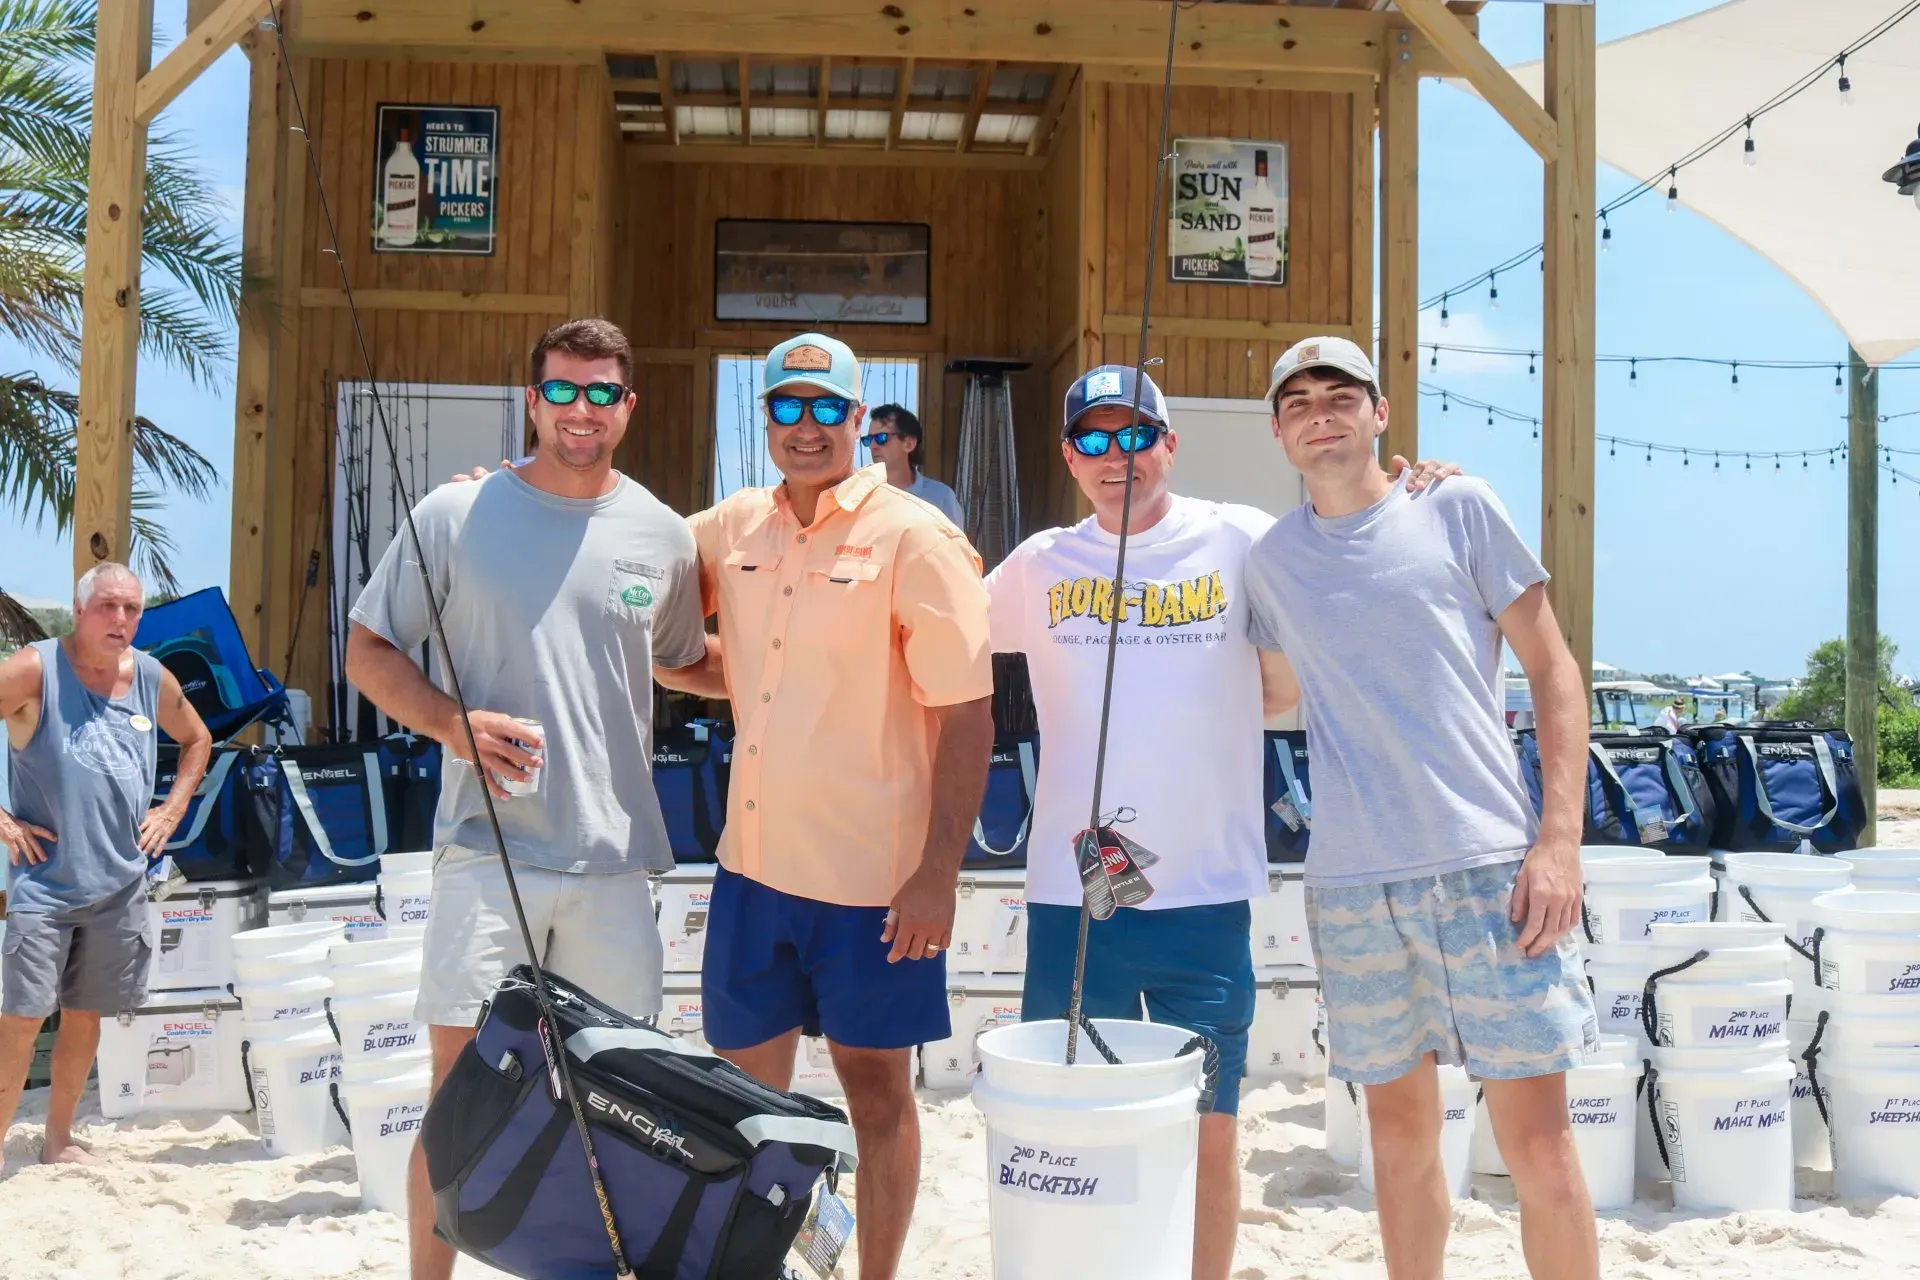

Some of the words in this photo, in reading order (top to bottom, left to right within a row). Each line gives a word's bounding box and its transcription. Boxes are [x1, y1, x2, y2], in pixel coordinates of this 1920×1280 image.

[454, 123, 464, 131] TO
[425, 136, 488, 153] STRUMMER
[1207, 160, 1221, 169] well
[1223, 160, 1238, 169] with
[424, 158, 489, 197] TIME
[1178, 172, 1242, 201] SUN
[440, 201, 484, 217] PICKERS
[1204, 200, 1219, 208] and
[1181, 212, 1241, 231] SAND
[1182, 258, 1219, 272] PICKERS
[1048, 570, 1228, 628] FLORA-BAMA
[1052, 634, 1083, 645] OUNGE,
[1085, 635, 1140, 645] PACAGE
[1144, 635, 1152, 645] &
[1156, 633, 1202, 644] OYSTER
[1205, 632, 1227, 642] BAR
[652, 754, 688, 762] NGEL
[1102, 850, 1125, 868] ENN
[1113, 879, 1133, 889] ATTLE
[400, 898, 414, 908] 3RD
[163, 910, 212, 918] ENGEL
[1650, 911, 1668, 922] 3RD
[1671, 910, 1690, 918] PLACE
[961, 942, 968, 951] 19
[1268, 936, 1275, 945] 19
[1615, 995, 1630, 1004] 2ND
[273, 1008, 288, 1019] 2ND
[291, 1007, 311, 1015] PLACE
[1611, 1006, 1630, 1018] RED
[1728, 1011, 1747, 1022] 2ND
[1750, 1010, 1769, 1018] PLACE
[368, 1023, 384, 1035] 2ND
[387, 1022, 410, 1030] PLACE
[1709, 1025, 1749, 1038] MAHI
[1753, 1022, 1780, 1038] MAHI
[363, 1034, 416, 1051] BLUEFISH
[1272, 1052, 1280, 1061] 30
[949, 1058, 957, 1068] 30
[300, 1069, 327, 1083] BLUE
[121, 1083, 130, 1094] 30
[1569, 1098, 1611, 1108] LARGEST
[1735, 1100, 1748, 1112] 1ST
[1751, 1100, 1771, 1108] PLACE
[1885, 1098, 1899, 1109] 1ST
[1902, 1098, 1920, 1106] PLAC
[402, 1105, 423, 1114] PLACE
[1571, 1112, 1617, 1123] IONFISH
[1713, 1115, 1754, 1130] MAHI
[1757, 1110, 1785, 1128] MAHI
[1870, 1111, 1920, 1124] SHEEPSH
[380, 1118, 422, 1136] BLUEFI
[1010, 1145, 1035, 1163] 2ND
[1039, 1150, 1078, 1166] PLACE
[1000, 1163, 1098, 1196] BLACKFISH
